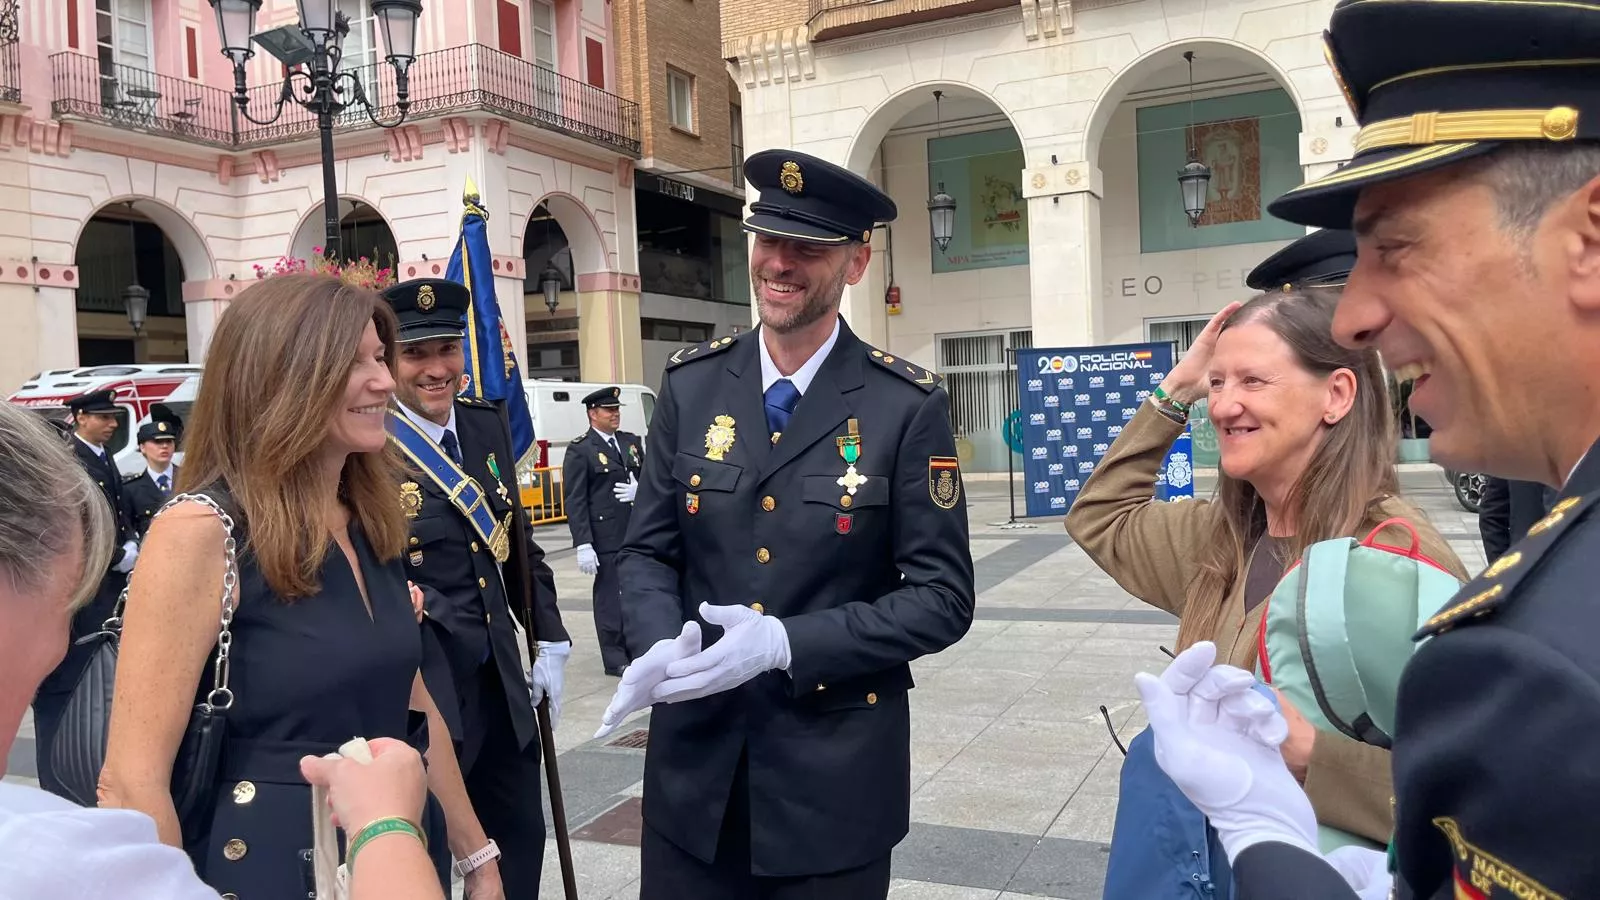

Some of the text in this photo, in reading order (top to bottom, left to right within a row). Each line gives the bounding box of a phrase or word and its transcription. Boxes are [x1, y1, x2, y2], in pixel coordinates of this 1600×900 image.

[657, 177, 695, 201] TATAU
[1038, 355, 1078, 374] 200
[1079, 352, 1137, 363] POLICIA
[1080, 360, 1152, 372] NACIONAL
